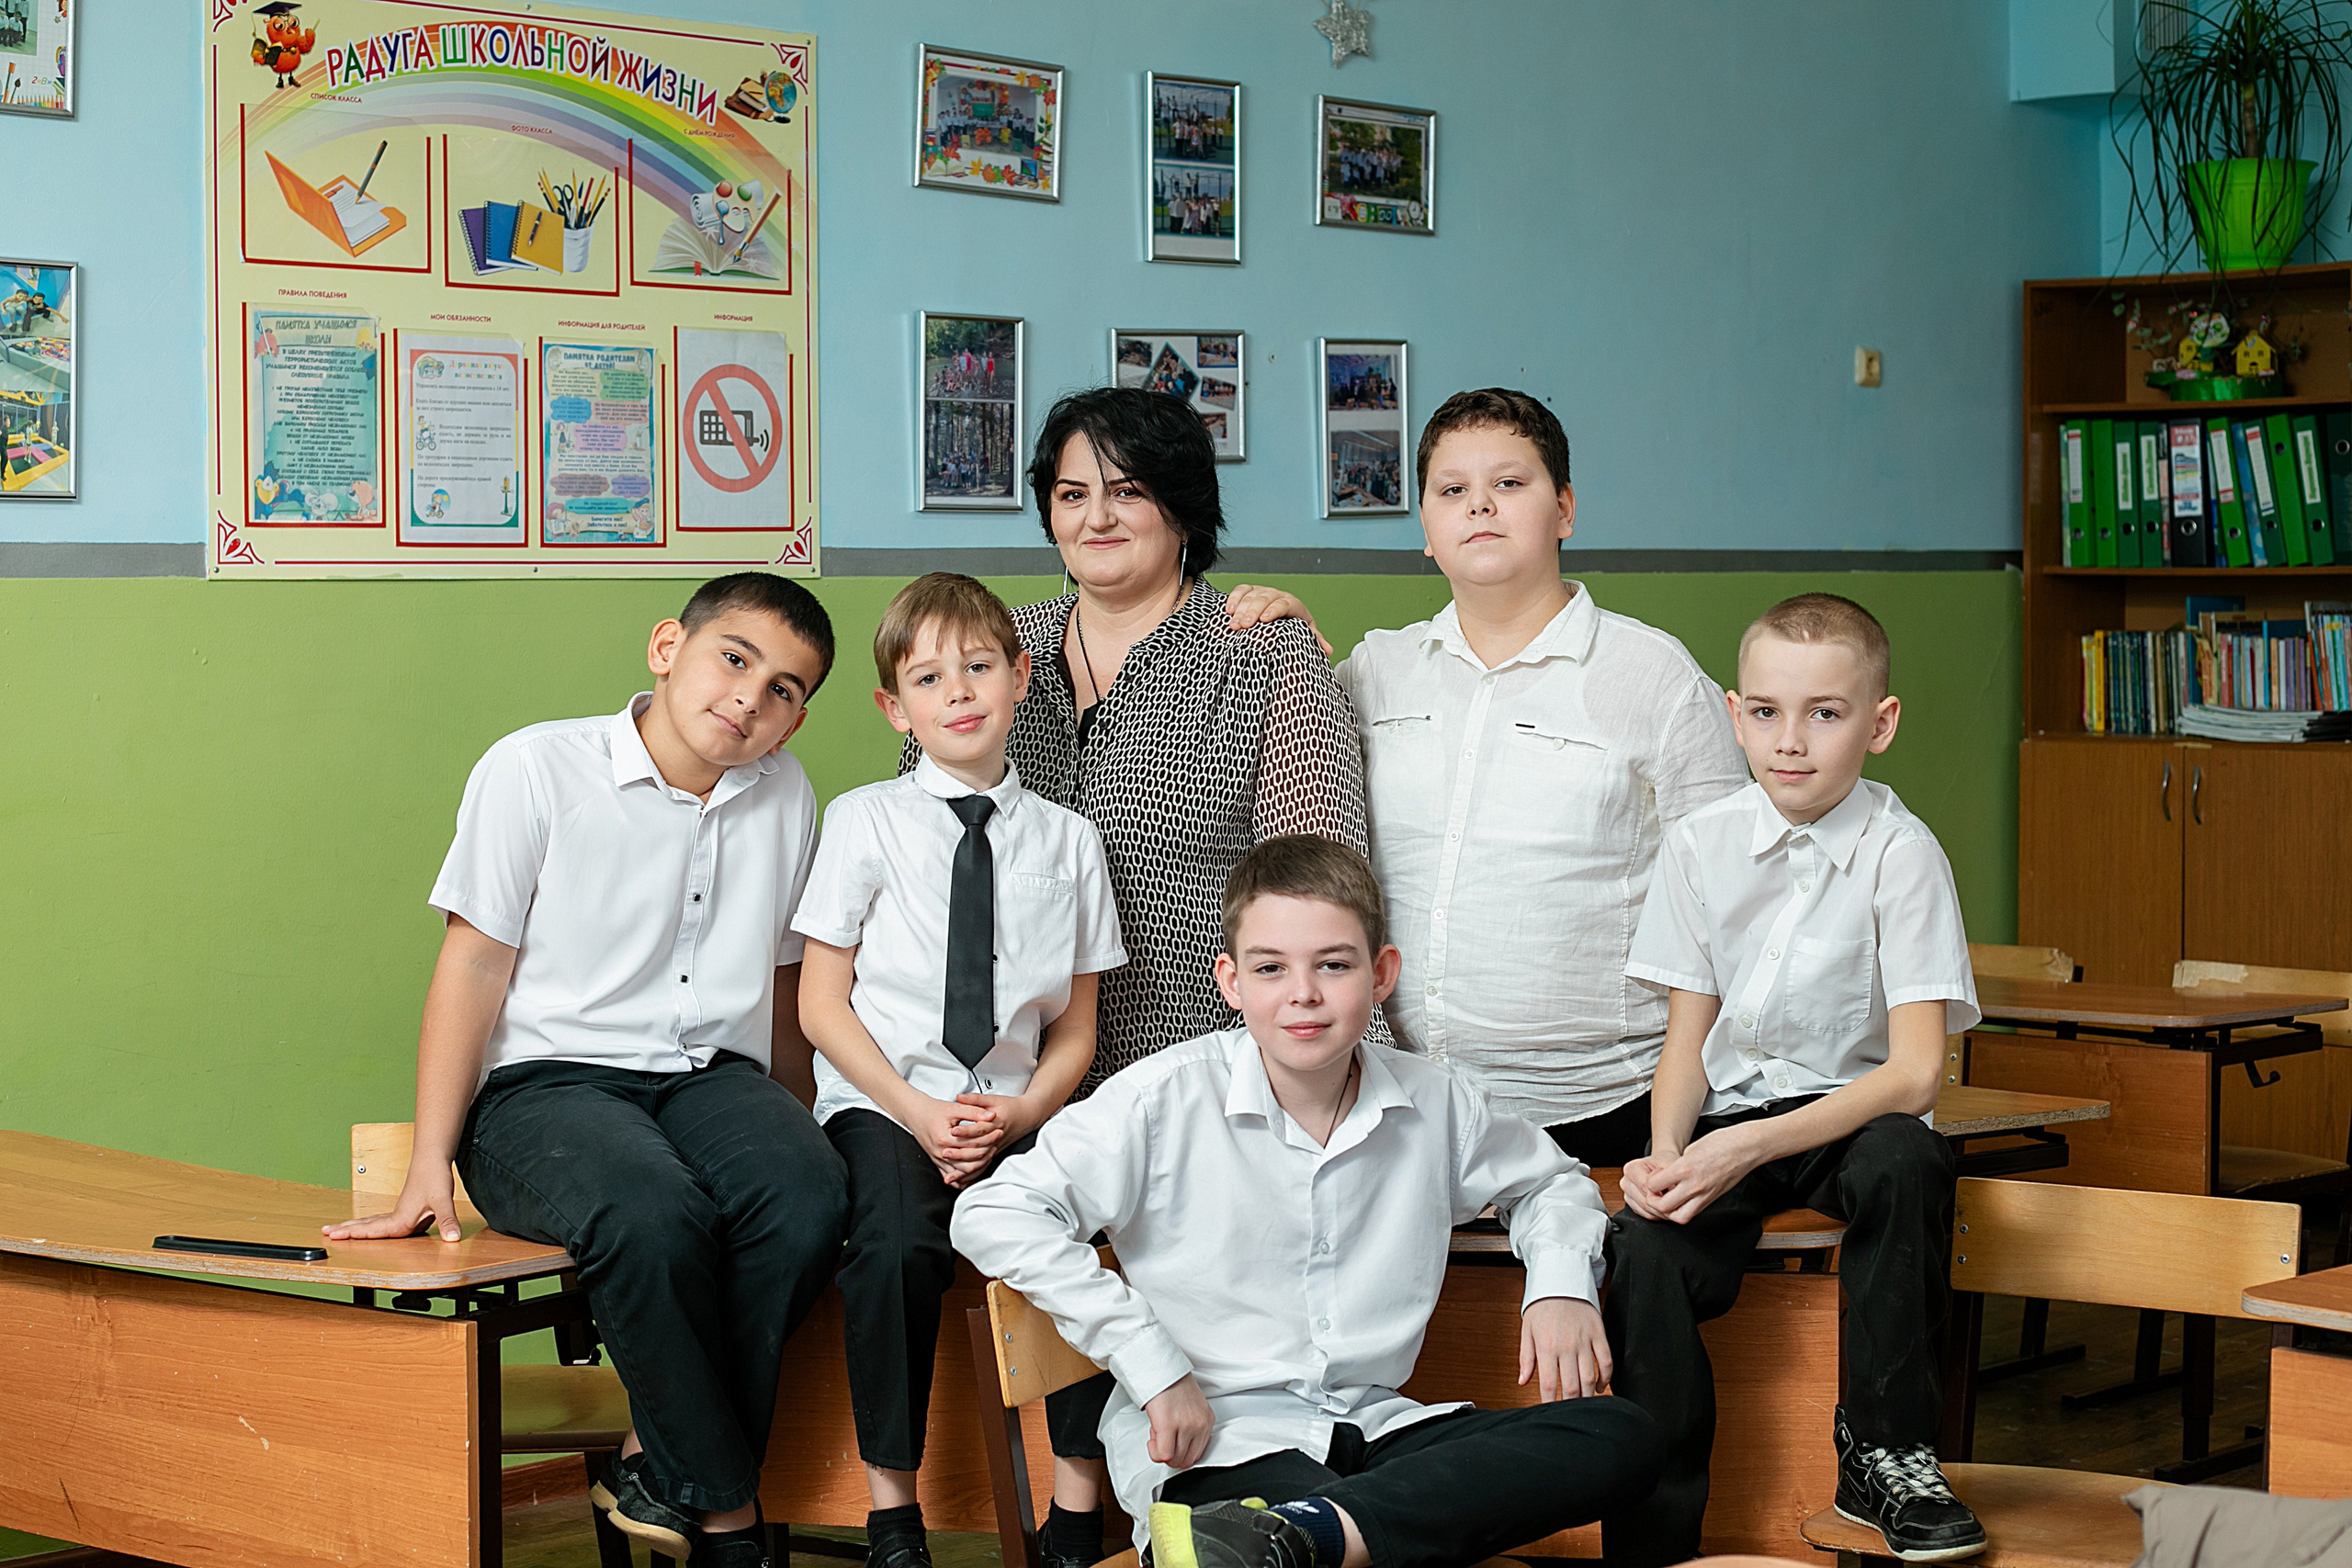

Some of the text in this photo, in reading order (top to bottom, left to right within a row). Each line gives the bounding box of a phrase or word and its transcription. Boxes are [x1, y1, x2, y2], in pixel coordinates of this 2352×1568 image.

[326, 26, 718, 124] РАДУГА ШКОЛЬНОЙ ЖИЗНИ
[311, 93, 336, 101] СПИСОК
[704, 130, 735, 138] РОЖДЕНИЯ
[278, 288, 347, 299] ПРАВИЛА ПОВЕДЕНИЯ
[447, 314, 492, 322] ОБЯЗАННОСТИ
[276, 320, 357, 330] ПАМЯТКА УЧАЩИМСЯ
[558, 321, 646, 331] ИНФОРМАЦИЯ ДЛЯ РОДИТЕЛЕЙ
[305, 334, 332, 344] ШКОЛЫ
